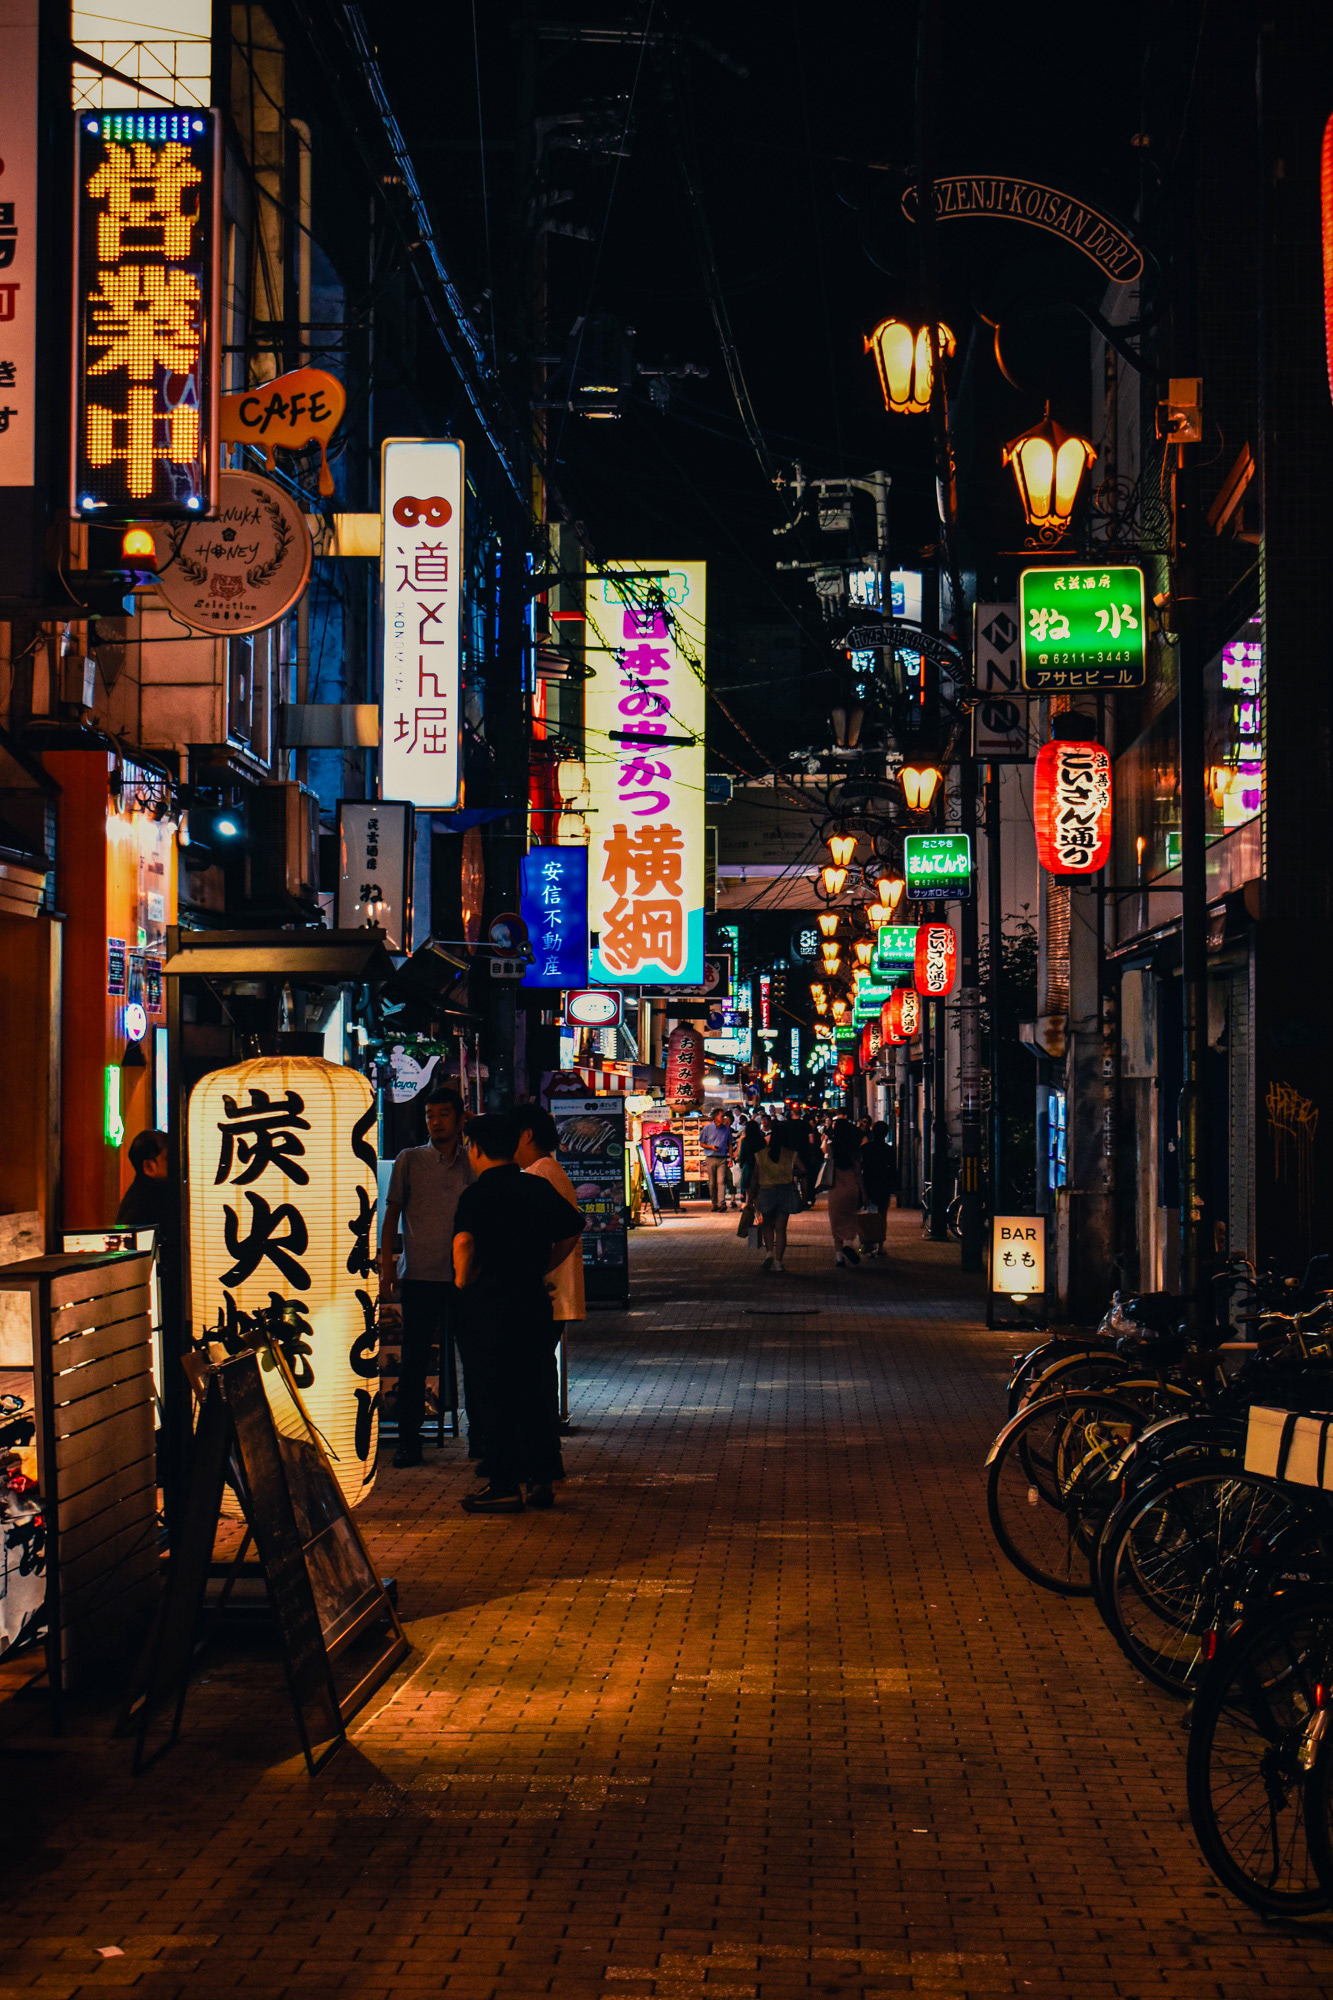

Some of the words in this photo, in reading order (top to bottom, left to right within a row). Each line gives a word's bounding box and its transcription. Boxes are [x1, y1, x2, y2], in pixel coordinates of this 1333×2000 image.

[86, 142, 202, 499] 営業中
[239, 390, 332, 434] CAFE
[1053, 574, 1112, 591] 民芸酒房
[194, 599, 257, 610] Selection
[393, 541, 449, 755] 道とん堀
[1053, 651, 1131, 664] 6211-3443
[1037, 669, 1133, 686] アサヒビール
[617, 609, 671, 817] 日本一の串かつ
[1096, 753, 1109, 806] 法善寺
[1060, 751, 1097, 865] こいさん通り
[921, 840, 953, 849] たこやき
[909, 854, 968, 874] まんてんや
[602, 823, 685, 972] 横綱
[913, 889, 964, 897] サッポロビール
[541, 861, 564, 976] 安信不動産
[676, 1036, 695, 1097] お好み焼
[1001, 1227, 1037, 1240] BAR
[1003, 1251, 1035, 1267] もも
